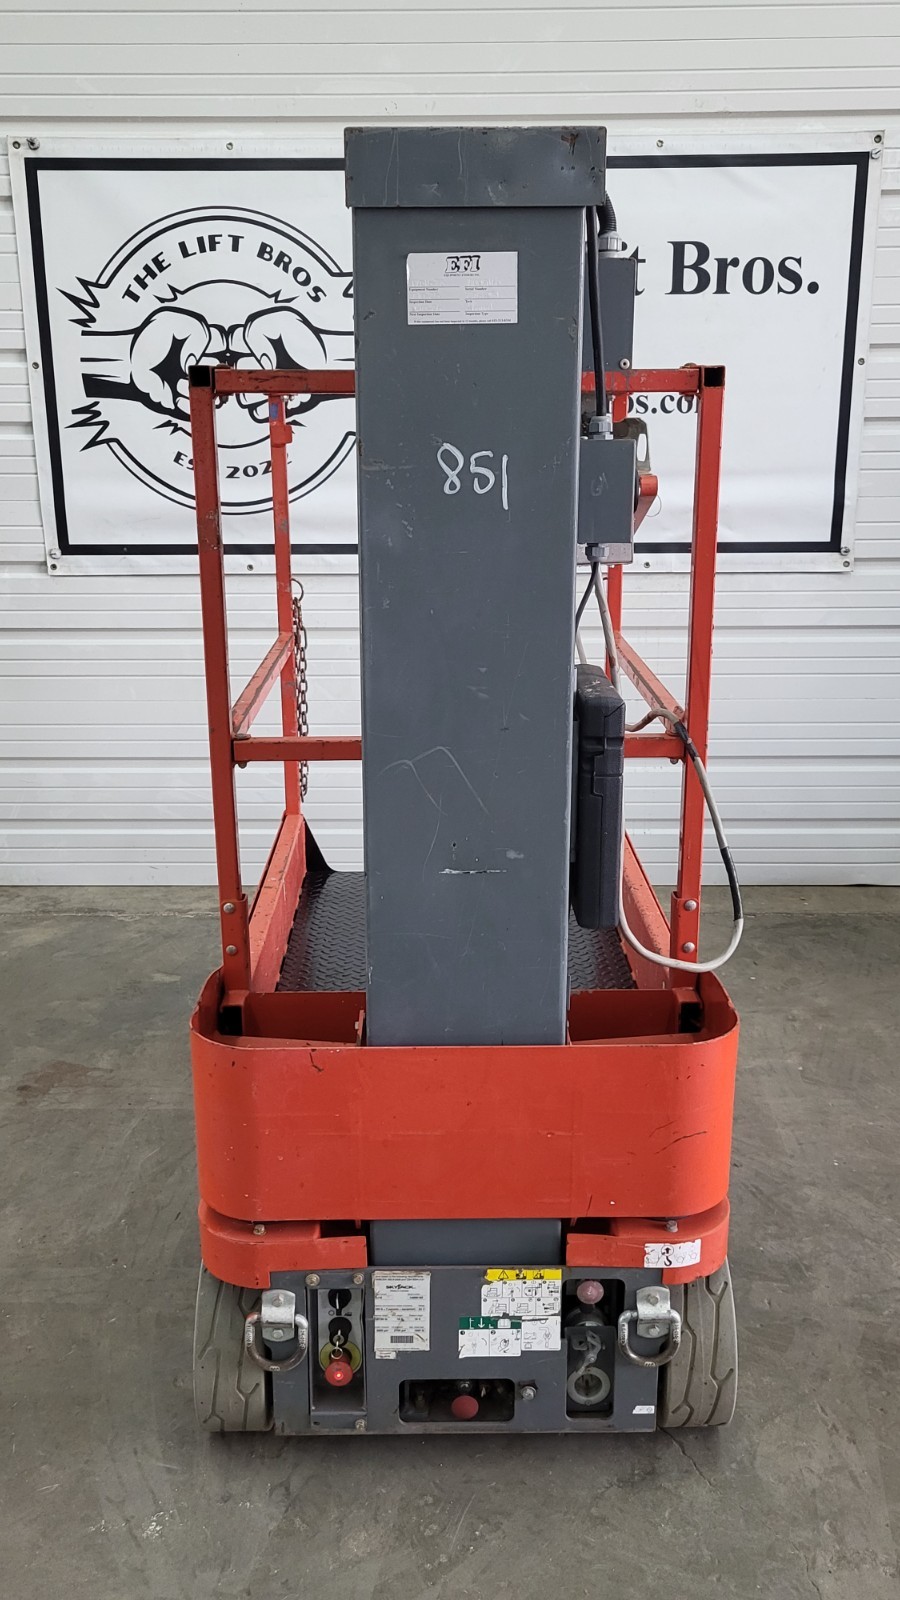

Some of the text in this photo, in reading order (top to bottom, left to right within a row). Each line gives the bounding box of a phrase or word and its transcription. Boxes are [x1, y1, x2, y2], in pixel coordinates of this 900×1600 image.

[121, 233, 327, 303] THE LIFT BROS
[664, 240, 820, 295] Bros.
[436, 442, 509, 511] 851
